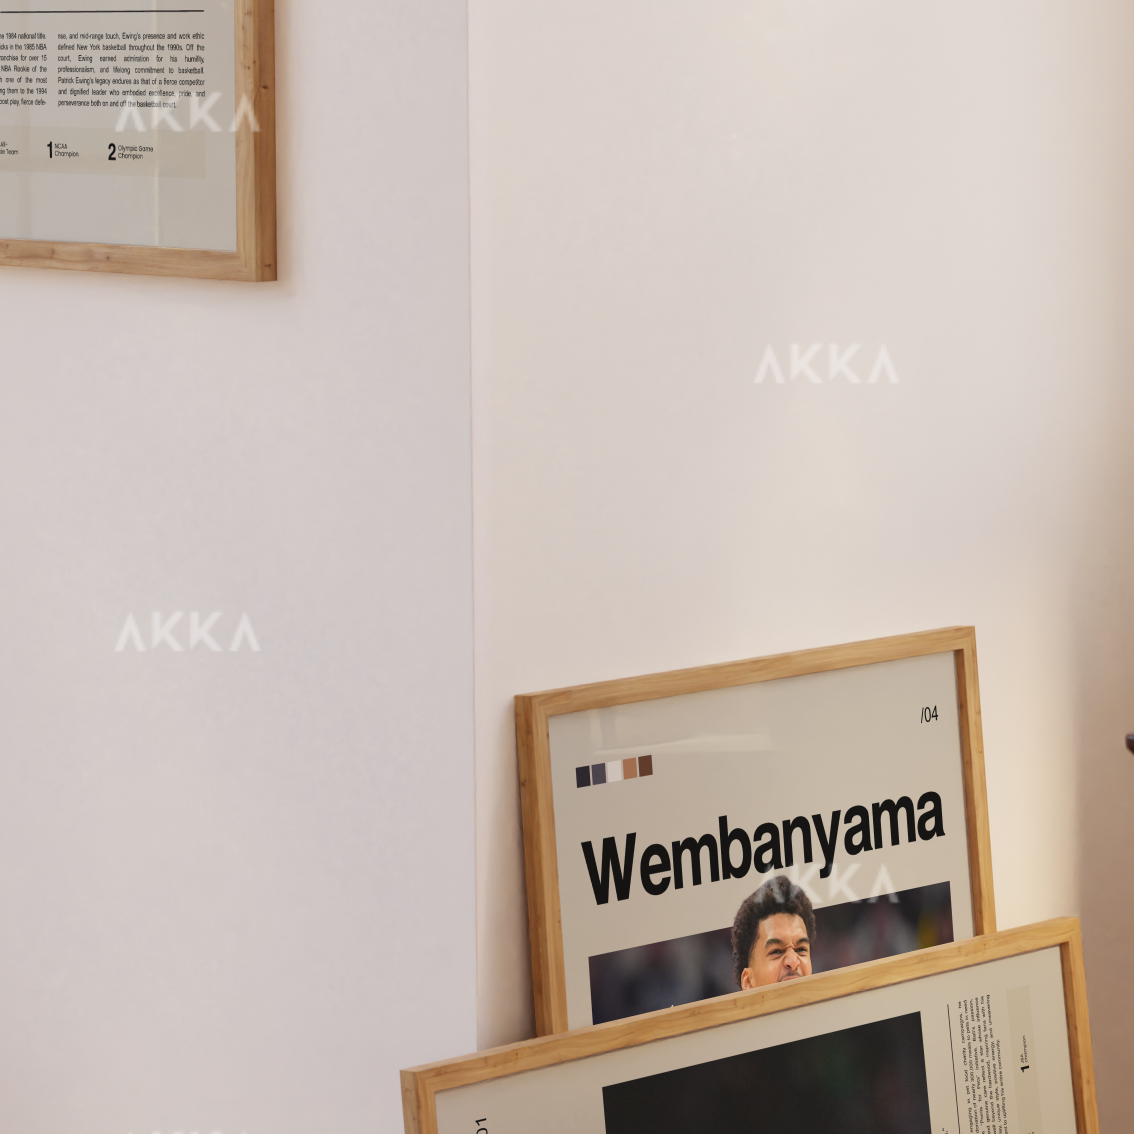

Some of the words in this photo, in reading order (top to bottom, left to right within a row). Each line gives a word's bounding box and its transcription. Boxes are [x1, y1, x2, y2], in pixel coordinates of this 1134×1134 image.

[5, 32, 17, 40] 1984
[17, 32, 37, 40] national
[68, 32, 79, 40] and
[79, 32, 104, 42] mid-range
[121, 32, 142, 42] Ewing's
[142, 33, 166, 42] presence
[166, 32, 177, 40] and
[178, 32, 191, 40] work
[191, 32, 205, 40] ethic
[9, 43, 14, 51] in
[14, 43, 23, 51] the
[23, 43, 36, 51] 1985
[35, 43, 48, 51] NBA
[57, 43, 75, 51] defined
[76, 43, 88, 51] New
[89, 43, 101, 51] York
[102, 43, 127, 52] basketball
[128, 43, 155, 53] throughout
[156, 43, 165, 52] the
[185, 43, 194, 52] Off
[196, 43, 205, 52] the
[77, 54, 93, 64] Ewing
[99, 54, 117, 63] earned
[155, 54, 164, 63] for
[169, 54, 178, 63] his
[0, 64, 12, 73] NBA
[99, 65, 110, 74] and
[168, 66, 175, 74] to
[57, 76, 75, 85] Patrick
[75, 76, 94, 87] Ewing's
[94, 76, 111, 87] legacy
[111, 77, 132, 85] endures
[132, 78, 140, 86] as
[140, 77, 151, 86] that
[151, 77, 157, 86] of
[158, 78, 163, 86] a
[163, 77, 178, 86] fierce
[178, 77, 205, 88] competitor
[57, 87, 68, 96] and
[91, 88, 107, 97] leader
[108, 88, 120, 97] who
[195, 89, 206, 98] and
[57, 100, 90, 109] perseverance
[90, 99, 102, 108] both
[109, 100, 119, 108] and
[119, 100, 127, 109] off
[47, 141, 52, 158] 1
[54, 150, 79, 158] Champion
[108, 143, 116, 160] 2
[118, 145, 138, 153] Olympic
[118, 152, 144, 160] Champion
[919, 706, 939, 724] /04
[581, 790, 946, 906] Wembanyama
